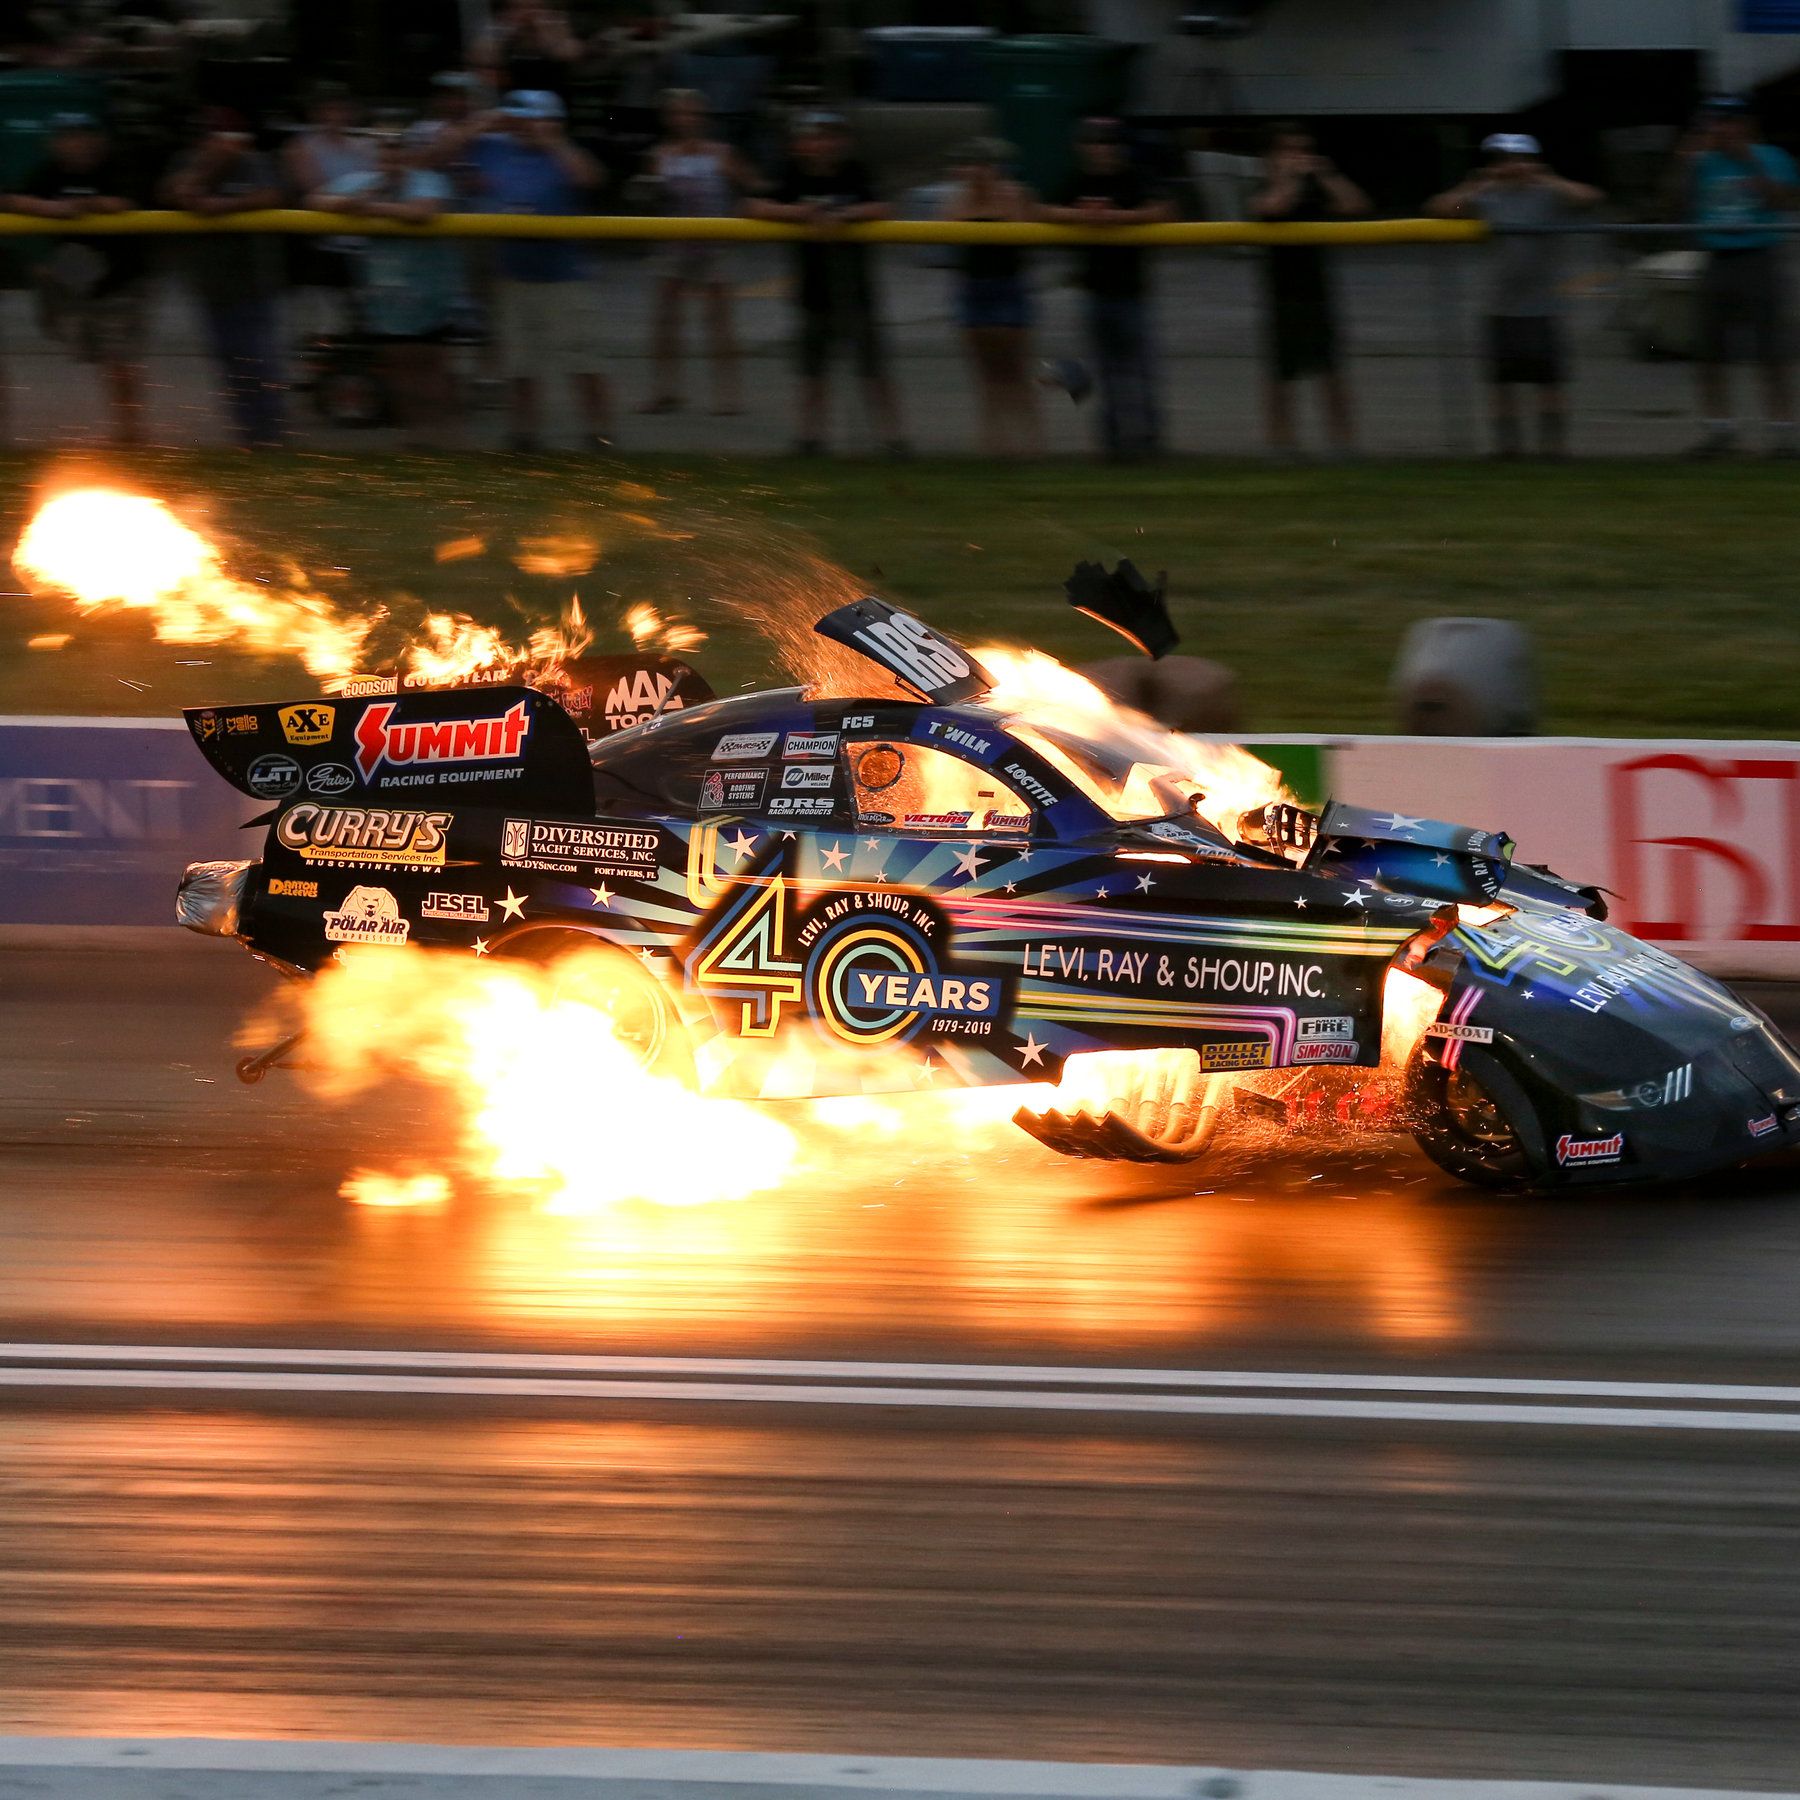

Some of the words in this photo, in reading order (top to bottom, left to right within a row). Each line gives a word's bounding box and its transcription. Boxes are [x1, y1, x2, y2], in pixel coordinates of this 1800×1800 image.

[853, 612, 970, 692] LRS
[343, 678, 396, 697] GOODSON
[287, 709, 330, 733] AXE
[842, 716, 874, 729] FC5
[788, 741, 835, 750] CHAMPION
[309, 767, 351, 791] Gates
[380, 774, 435, 788] RACING
[439, 768, 525, 783] EQUIPMENT
[724, 772, 765, 780] PERFORMANCE
[804, 773, 831, 782] Miller
[730, 784, 756, 792] ROOFING
[1004, 763, 1058, 806] LOCTITE
[728, 792, 755, 800] SYSTEMS
[770, 798, 834, 809] QRS
[768, 808, 793, 816] RACING
[795, 808, 832, 816] PRODUCTS
[905, 814, 969, 824] VICTORY
[532, 825, 659, 850] DIVERSIFIED
[309, 847, 379, 860] Transportation
[381, 851, 421, 862] Services
[423, 855, 440, 863] Inc.
[532, 843, 571, 855] YACHT
[572, 846, 629, 861] SERVICES,
[632, 851, 656, 862] INC.
[306, 859, 397, 873] MUSCATINE,
[404, 865, 442, 874] IOWA
[594, 867, 616, 876] FORT
[616, 869, 645, 879] MYERS,
[646, 871, 656, 879] FL
[282, 889, 318, 898] SLEEVES
[422, 892, 487, 914] JESEL
[329, 918, 378, 932] POLAR
[379, 919, 406, 934] AIR
[797, 918, 828, 947] LEVI,
[825, 897, 849, 920] RAY
[854, 894, 863, 909] &
[867, 893, 910, 919] SHOUP,
[912, 909, 936, 937] INC.
[328, 931, 405, 943] COMPRESSORS
[1097, 949, 1149, 984] RAY
[1156, 955, 1174, 986] &
[1277, 963, 1326, 998] INC.
[858, 972, 991, 1012] YEARS
[931, 1018, 992, 1035] 1979-2019
[1302, 1020, 1348, 1034] FIRE
[1204, 1043, 1270, 1061] BULLET
[1296, 1044, 1352, 1059] SIMPSON
[1241, 1058, 1264, 1066] CAMS
